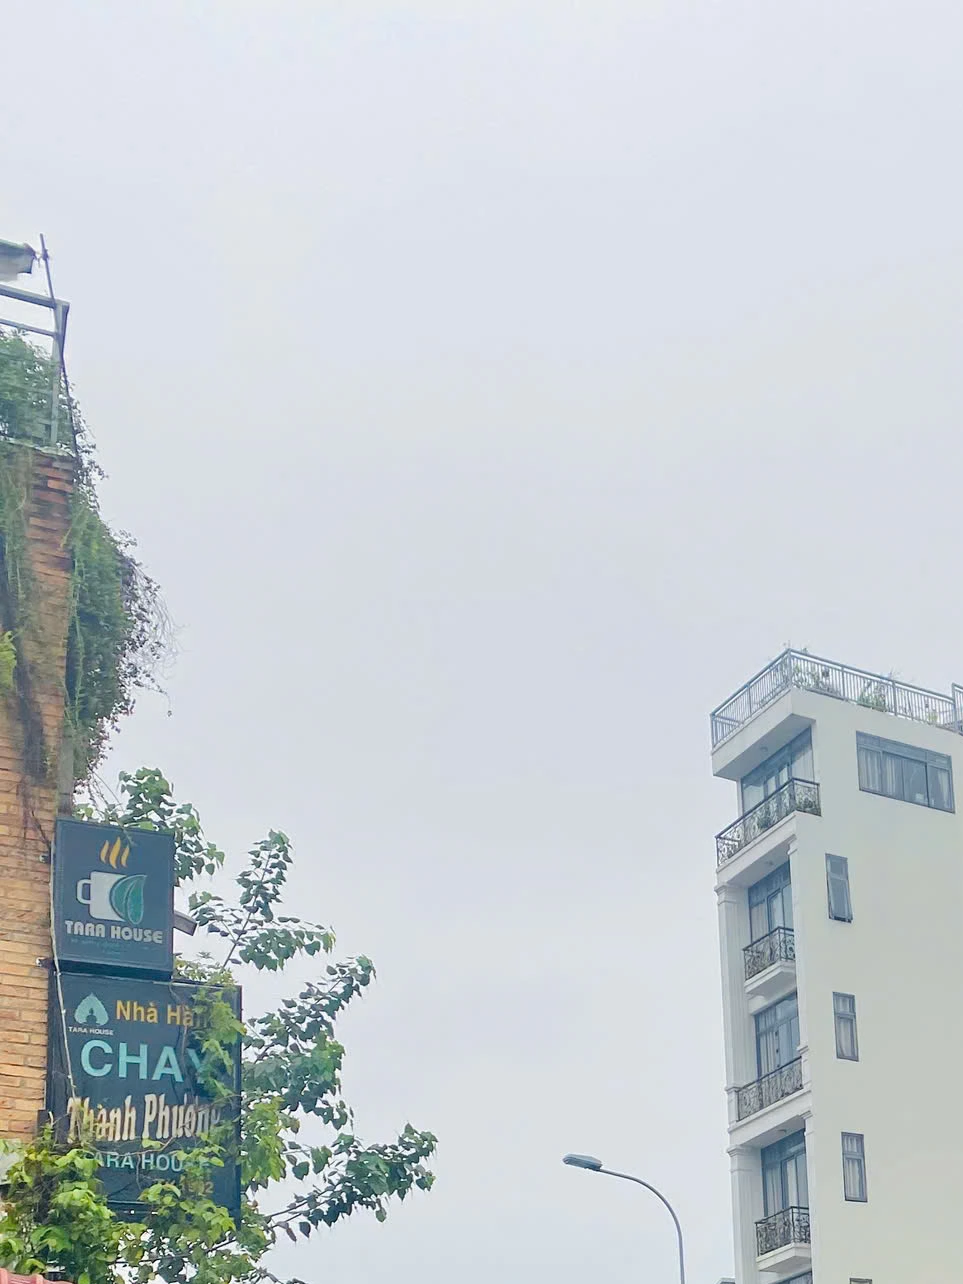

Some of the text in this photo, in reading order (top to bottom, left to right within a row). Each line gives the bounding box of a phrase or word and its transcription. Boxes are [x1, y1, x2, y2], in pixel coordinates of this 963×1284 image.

[65, 920, 163, 944] TARA HOUSE
[116, 1000, 158, 1024] Nhà
[68, 1026, 114, 1036] TARA HOUSE
